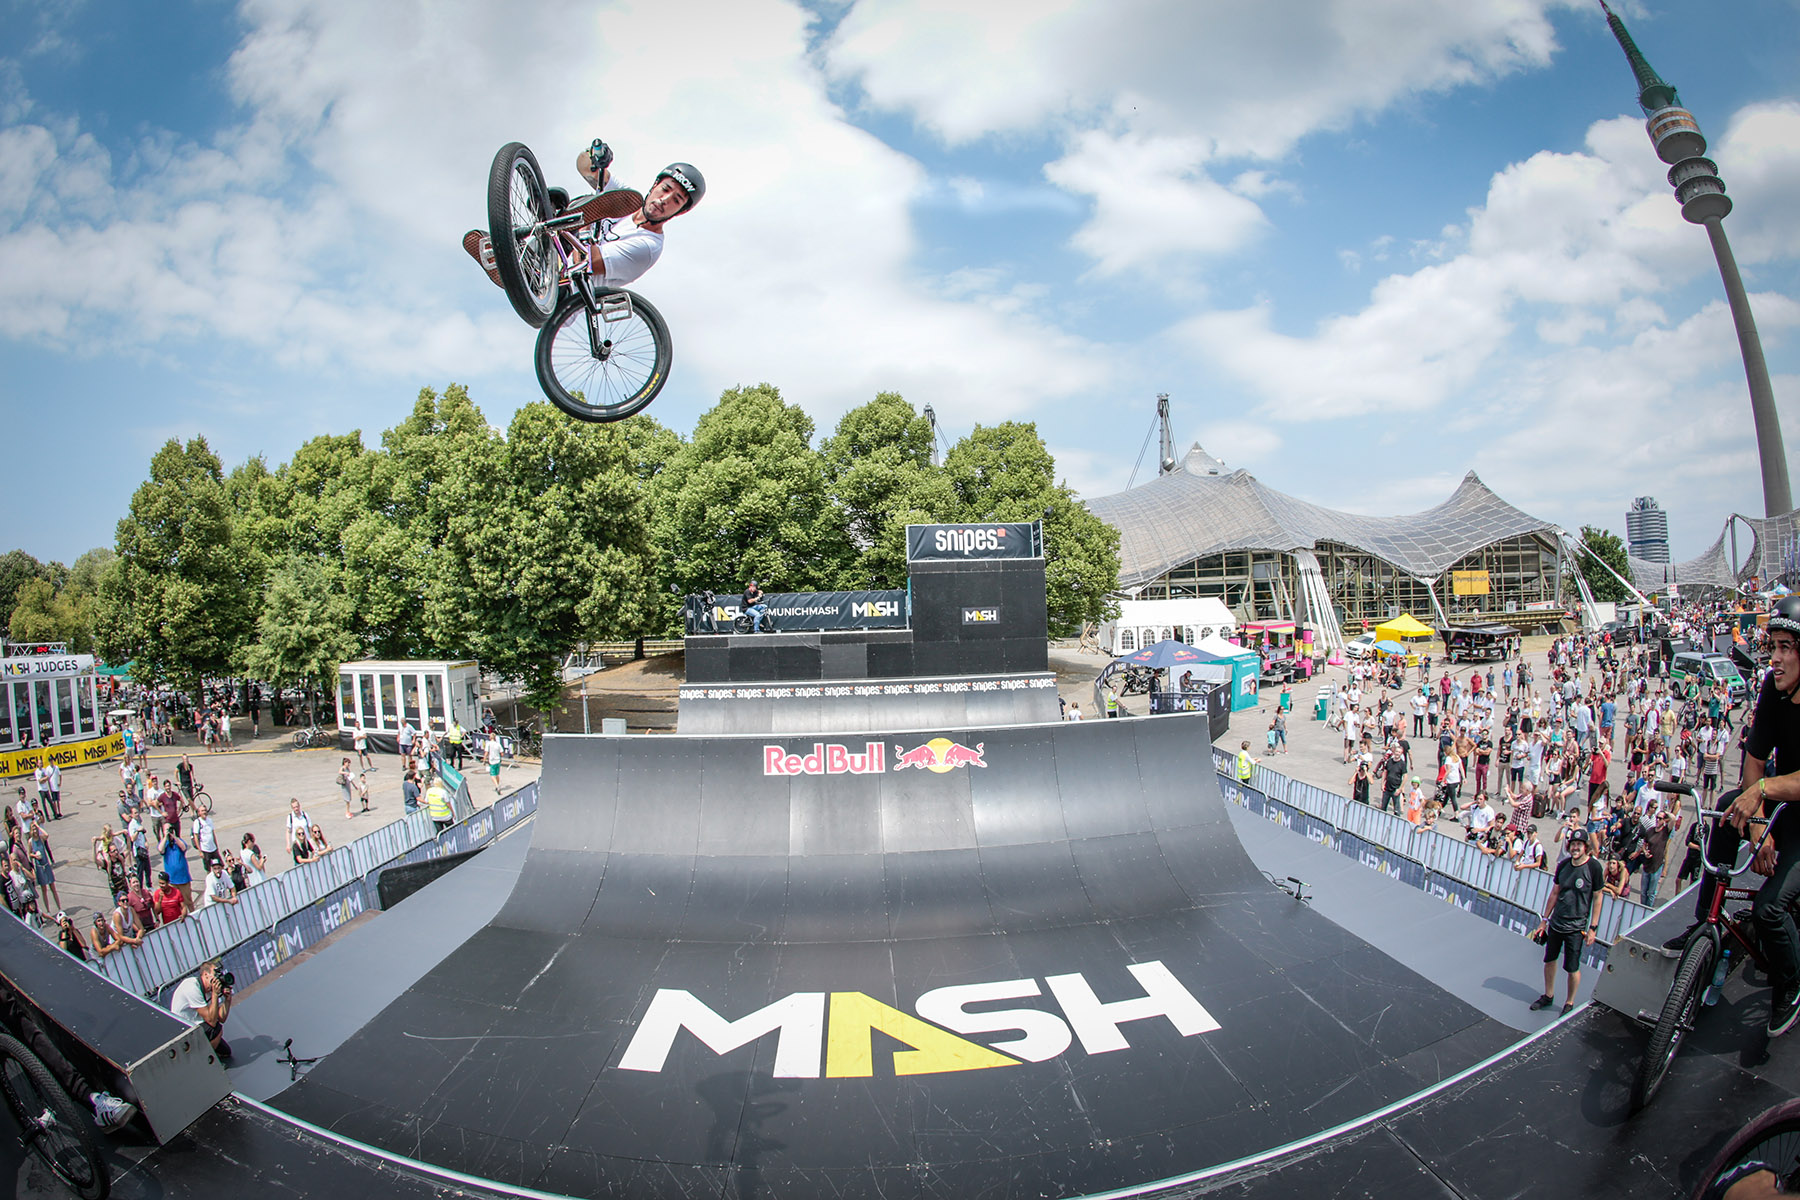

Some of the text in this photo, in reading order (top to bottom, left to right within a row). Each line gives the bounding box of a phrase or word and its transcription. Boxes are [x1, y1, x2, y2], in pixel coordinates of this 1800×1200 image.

[935, 529, 998, 555] snipes
[852, 601, 898, 617] MASH
[965, 610, 997, 621] MASH
[5, 660, 78, 675] MASH JUDGES
[680, 678, 1054, 700] snipes snipes snipes snipes snipes snipes snipes snipes snipes snipes snipes snipes snipes
[1174, 699, 1208, 710] MASH
[16, 755, 43, 772] MASH
[49, 750, 77, 765] MASH
[84, 744, 107, 760] MASH
[764, 742, 885, 775] Red Bull
[618, 960, 1222, 1078] MASH
